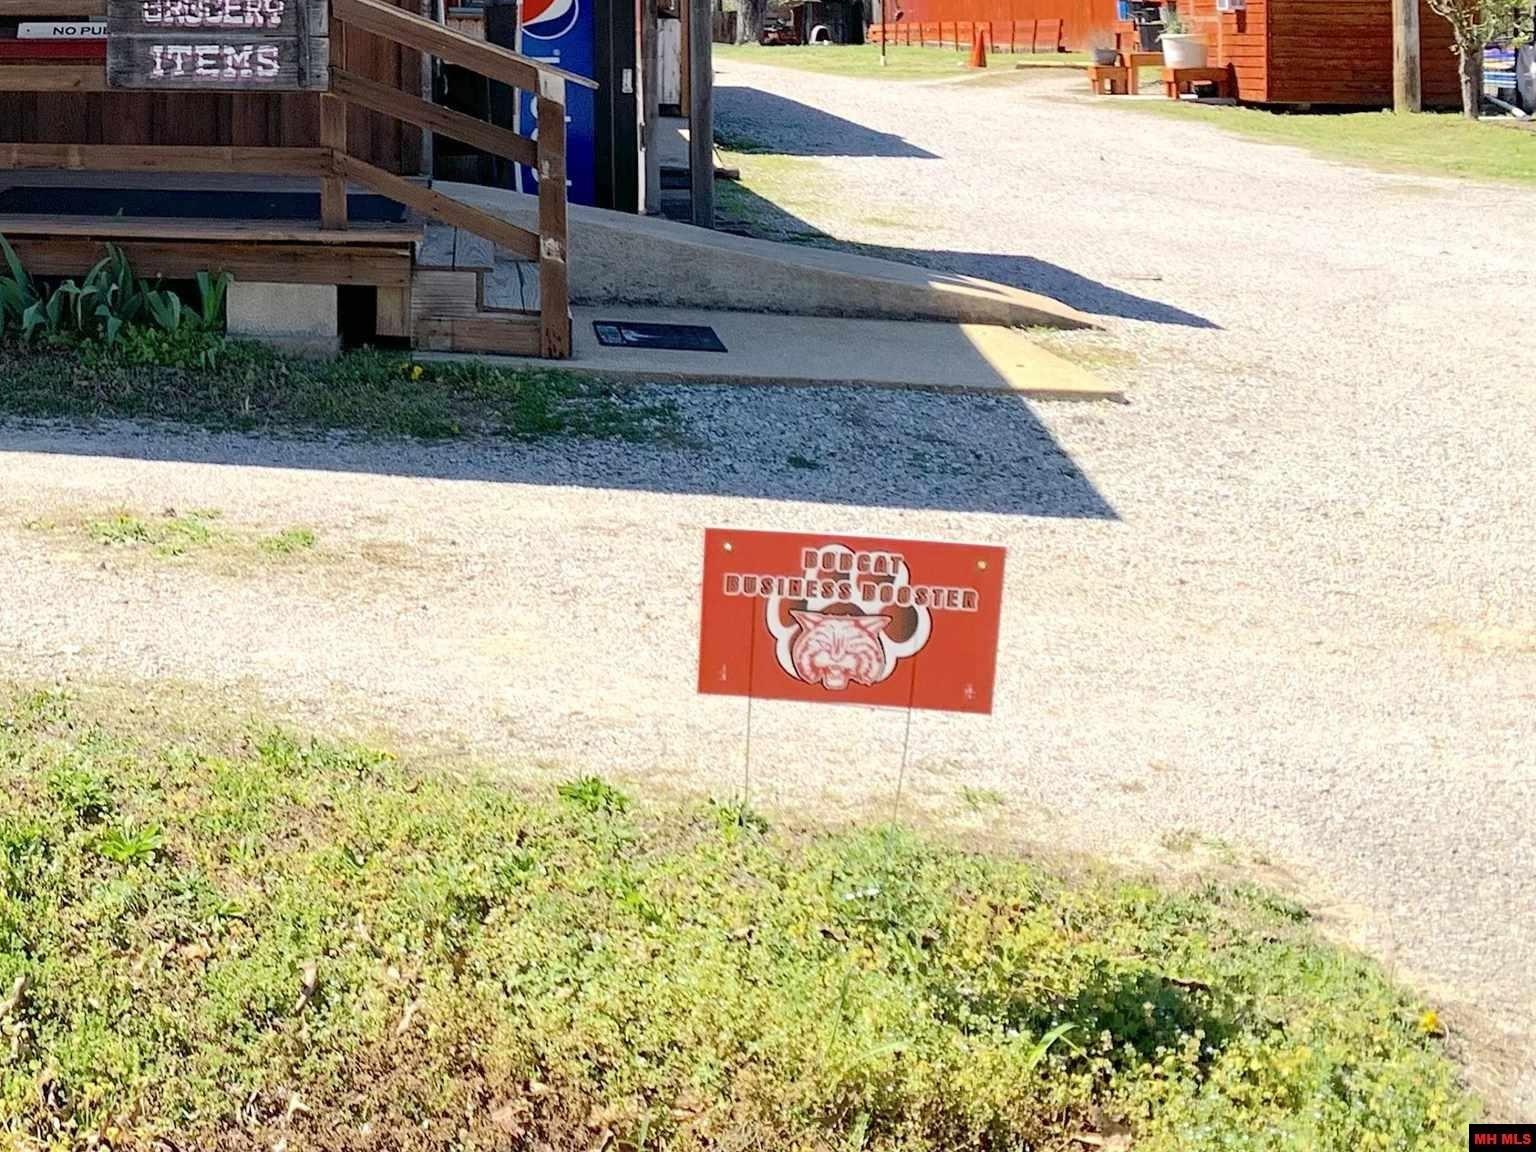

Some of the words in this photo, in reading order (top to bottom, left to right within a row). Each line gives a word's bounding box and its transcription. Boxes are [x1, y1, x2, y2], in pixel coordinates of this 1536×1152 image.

[52, 26, 77, 36] NO
[150, 44, 282, 80] ITEMS
[802, 549, 903, 576] BOBCAT
[725, 574, 852, 601] BUSINESS
[861, 583, 978, 611] BOOSTER
